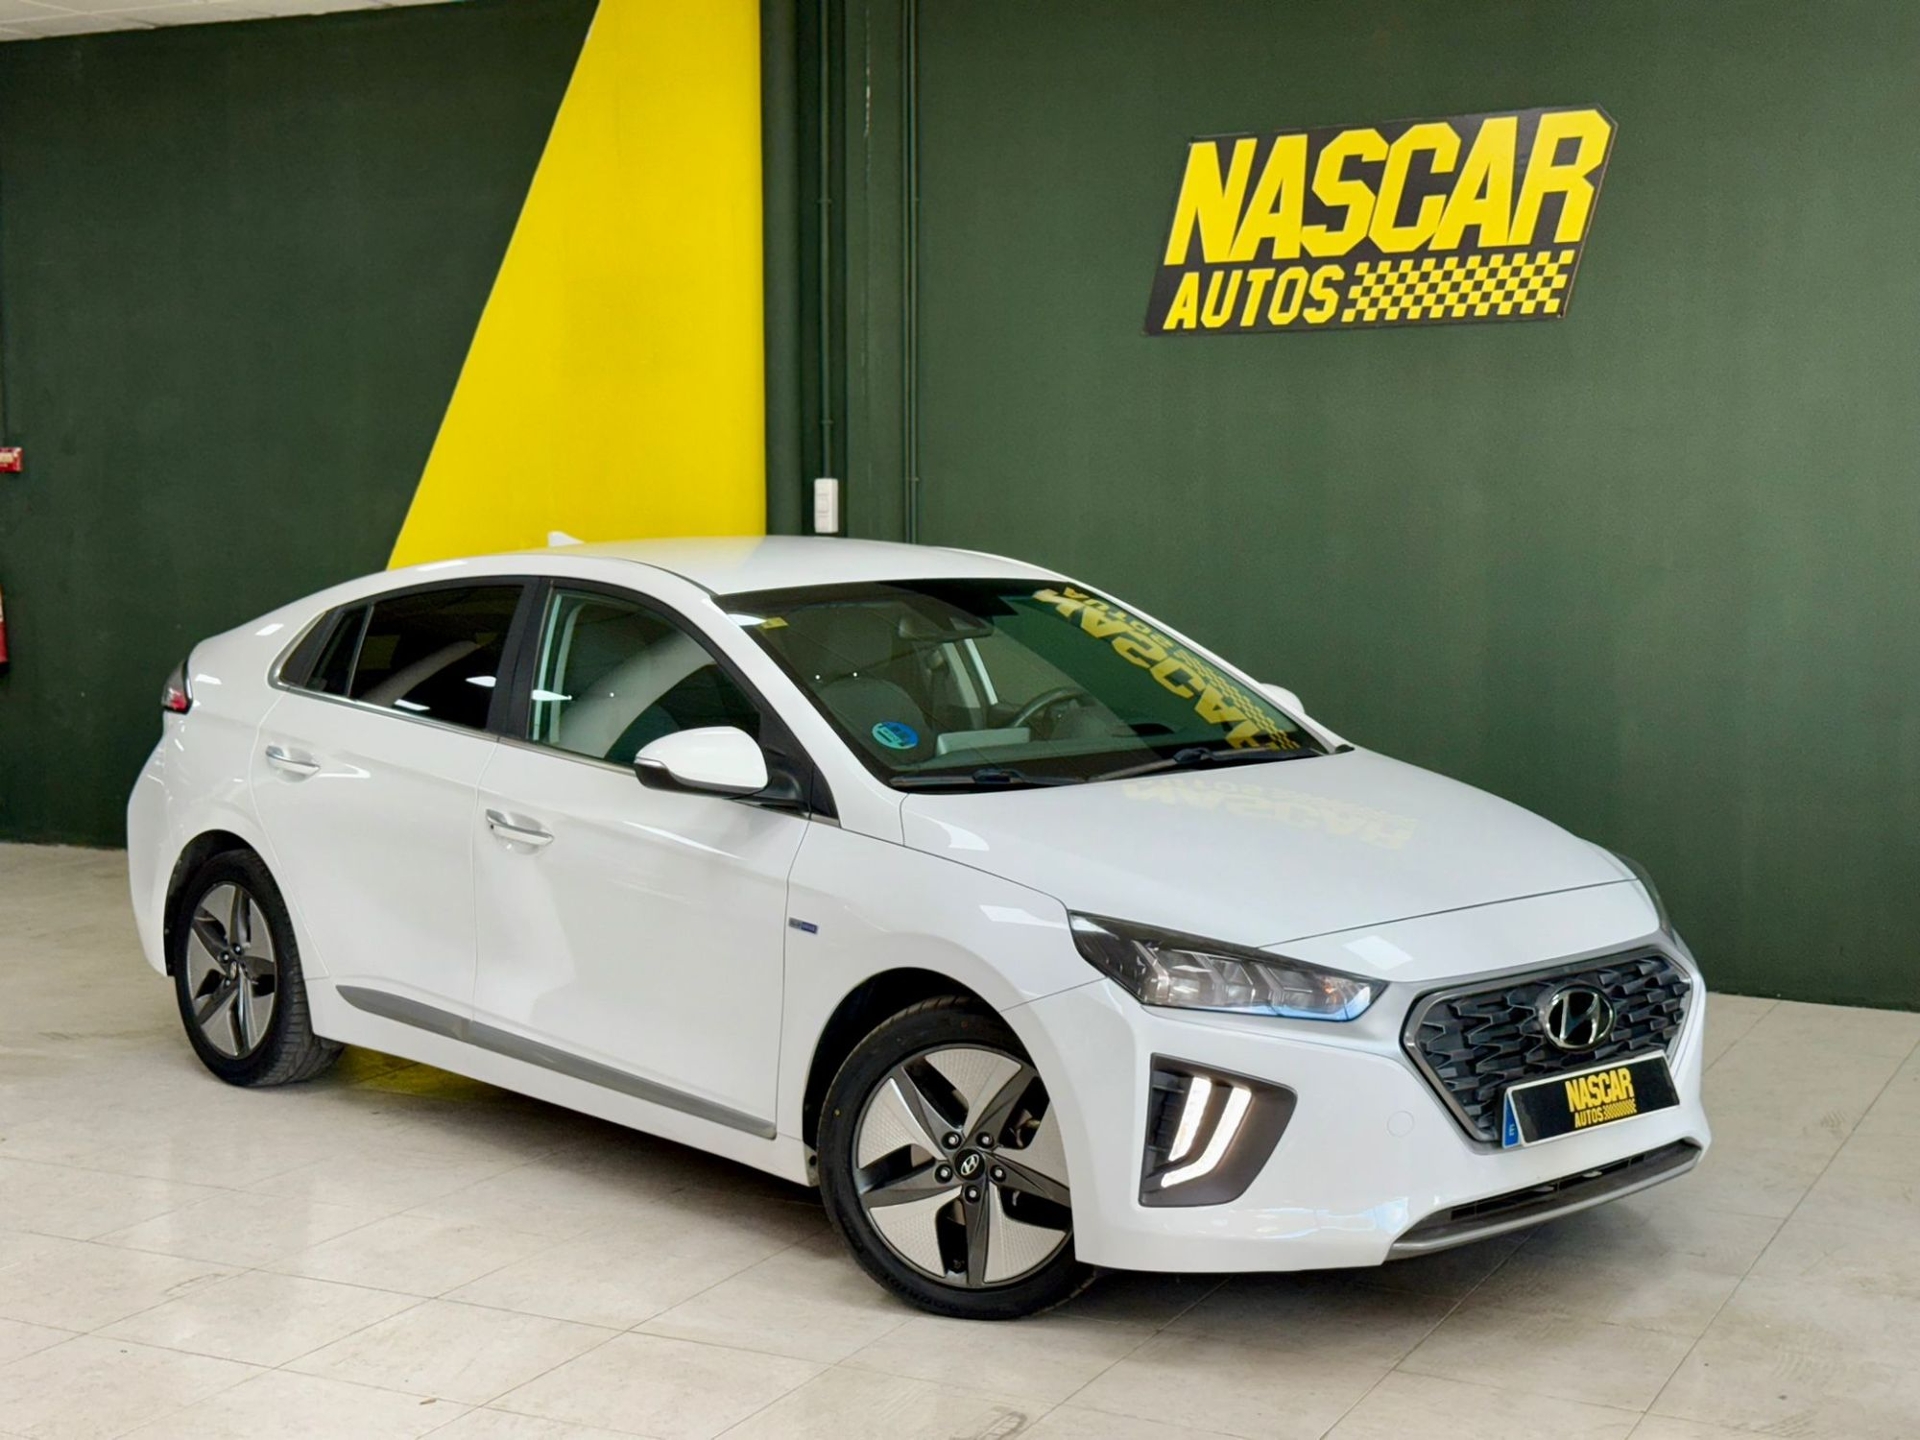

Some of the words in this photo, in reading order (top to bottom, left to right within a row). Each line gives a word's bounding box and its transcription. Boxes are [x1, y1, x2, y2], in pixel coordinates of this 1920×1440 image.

[1164, 109, 1611, 265] NASCAR
[1163, 264, 1345, 330] AUTOS
[1565, 1067, 1634, 1112] NASCAR
[1574, 1107, 1604, 1128] AUTOS
